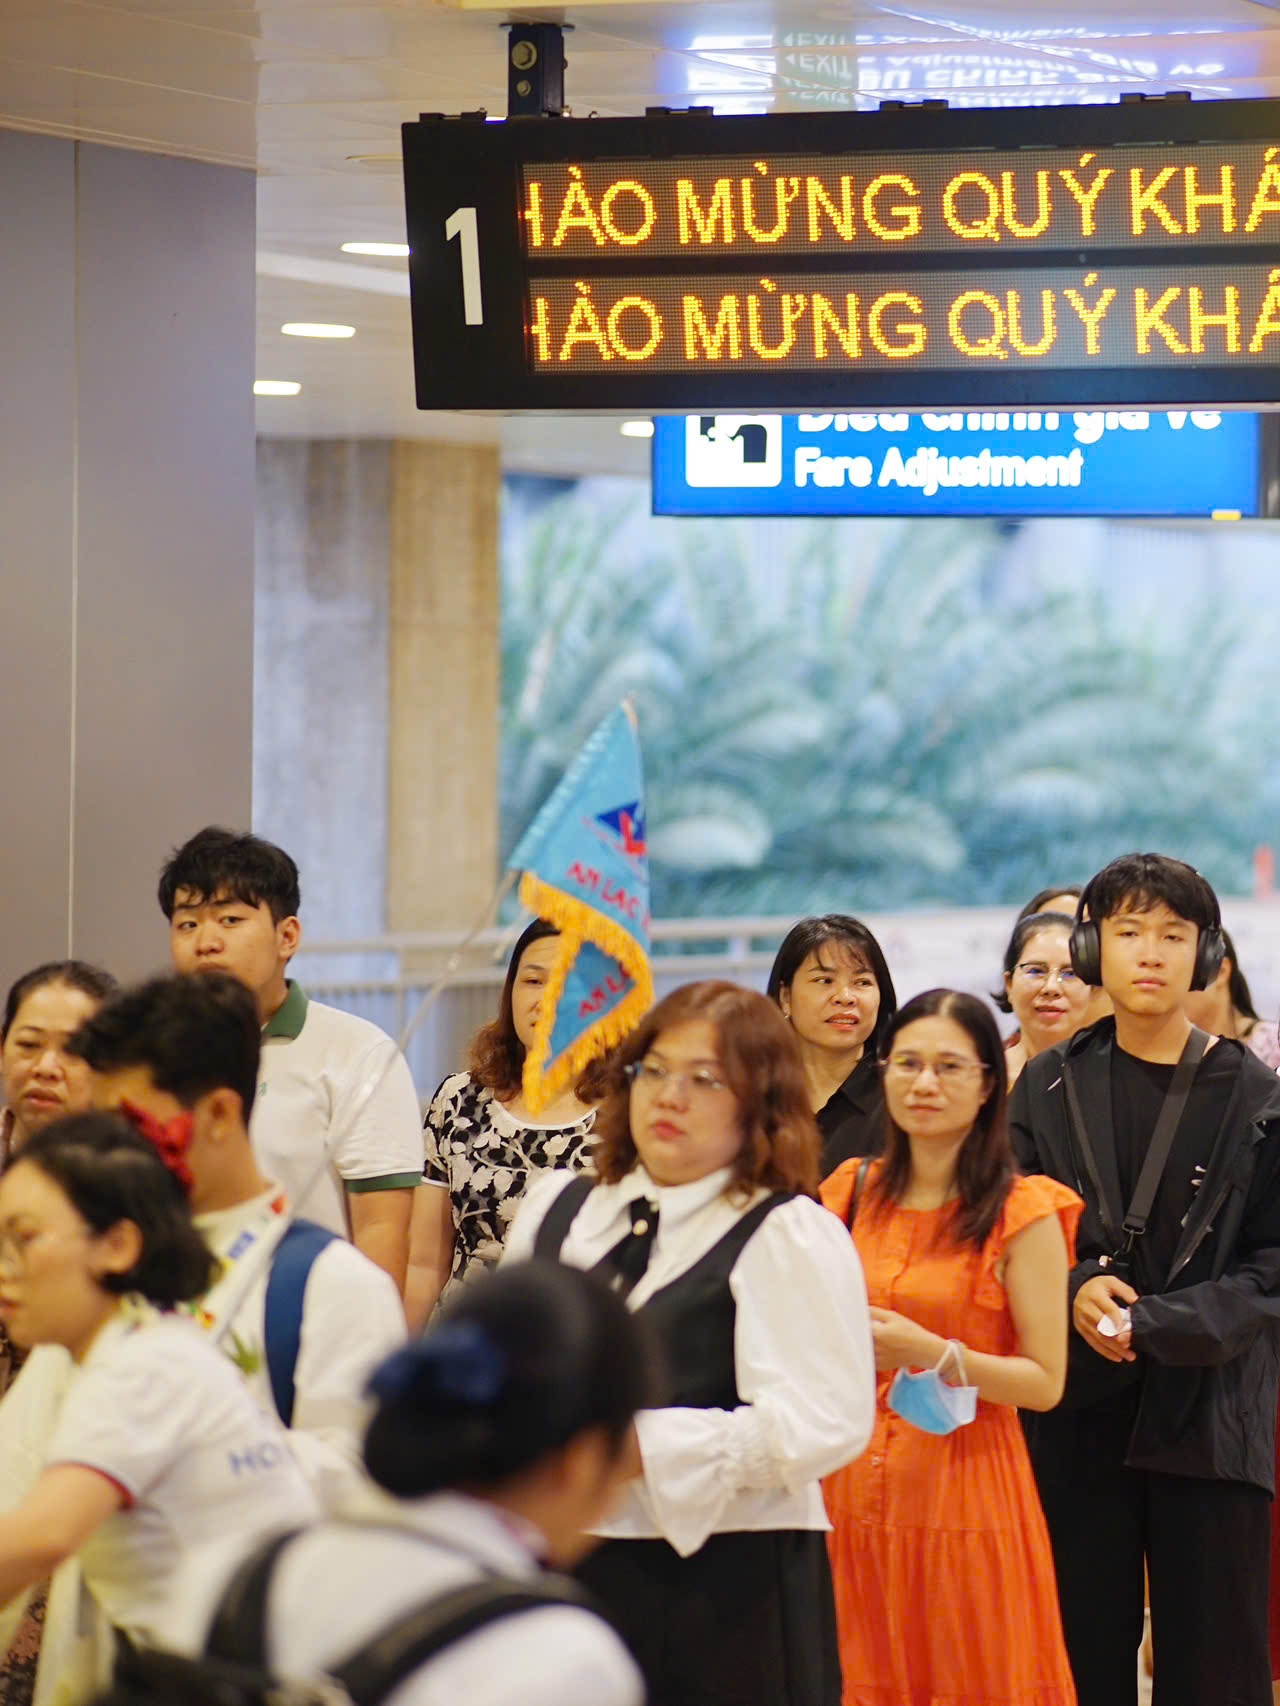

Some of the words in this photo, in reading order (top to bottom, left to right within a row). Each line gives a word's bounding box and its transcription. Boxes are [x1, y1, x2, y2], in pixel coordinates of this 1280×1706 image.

[677, 161, 921, 244] MỪNG
[943, 153, 1114, 241] QUÝ
[445, 207, 483, 325] 1
[683, 278, 928, 360] MỪNG
[948, 273, 1116, 360] QUÝ
[795, 447, 872, 487] Fare
[878, 447, 1083, 496] Adjustment
